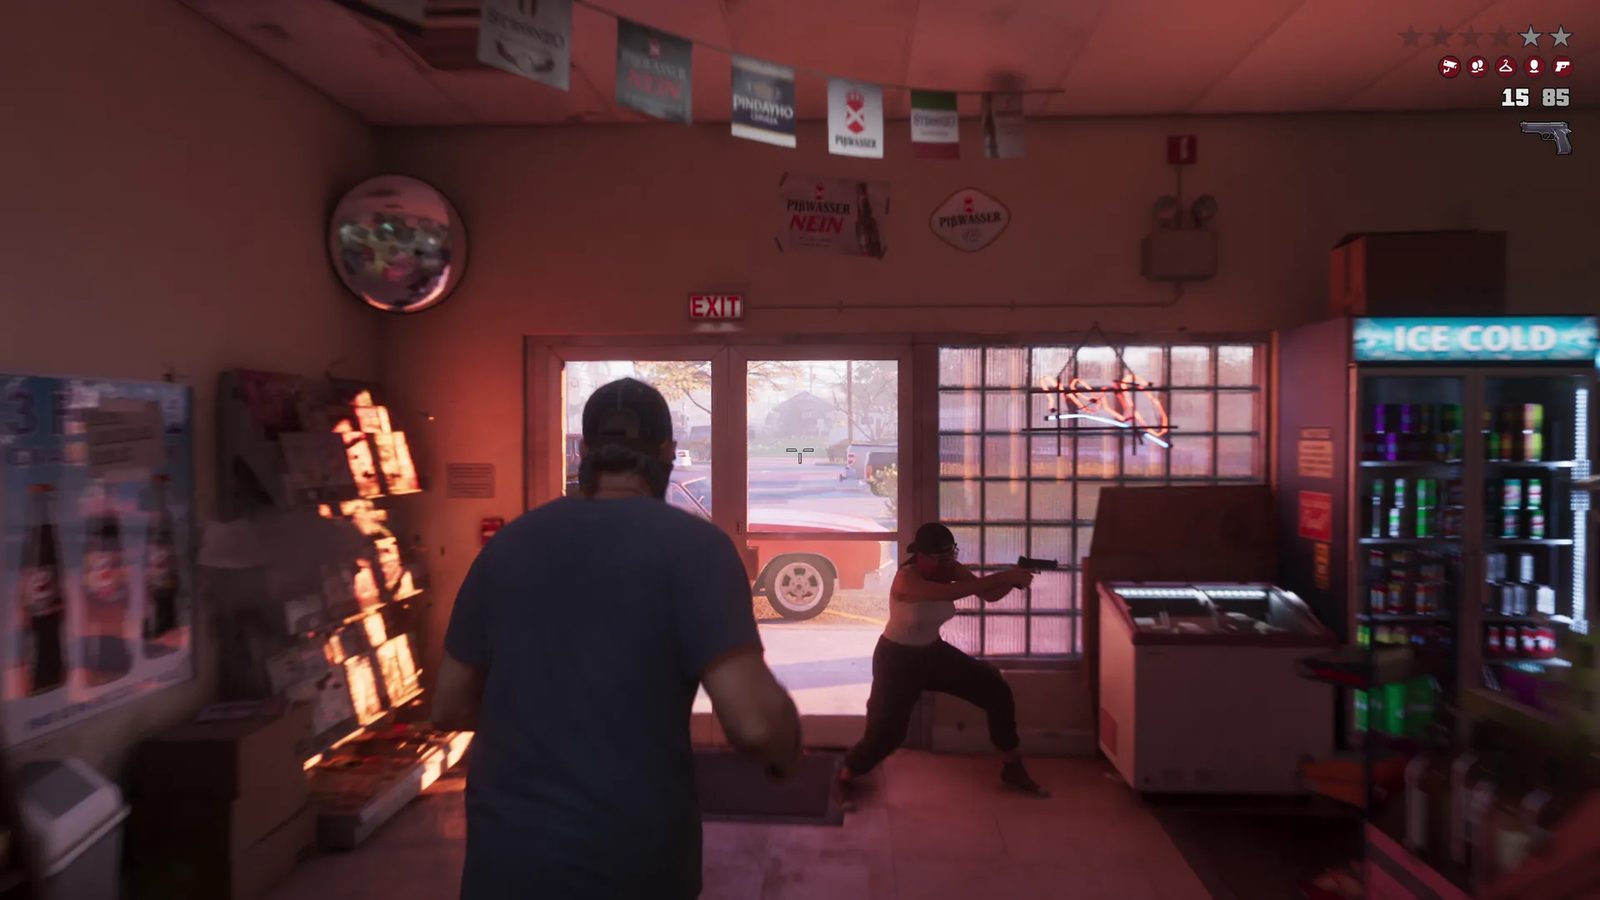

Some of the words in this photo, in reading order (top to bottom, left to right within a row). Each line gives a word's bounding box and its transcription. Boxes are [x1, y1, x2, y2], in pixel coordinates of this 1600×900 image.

[789, 214, 844, 235] NEIN
[690, 296, 741, 319] EXIT
[1393, 325, 1450, 352] ICE
[1459, 325, 1558, 352] COLD
